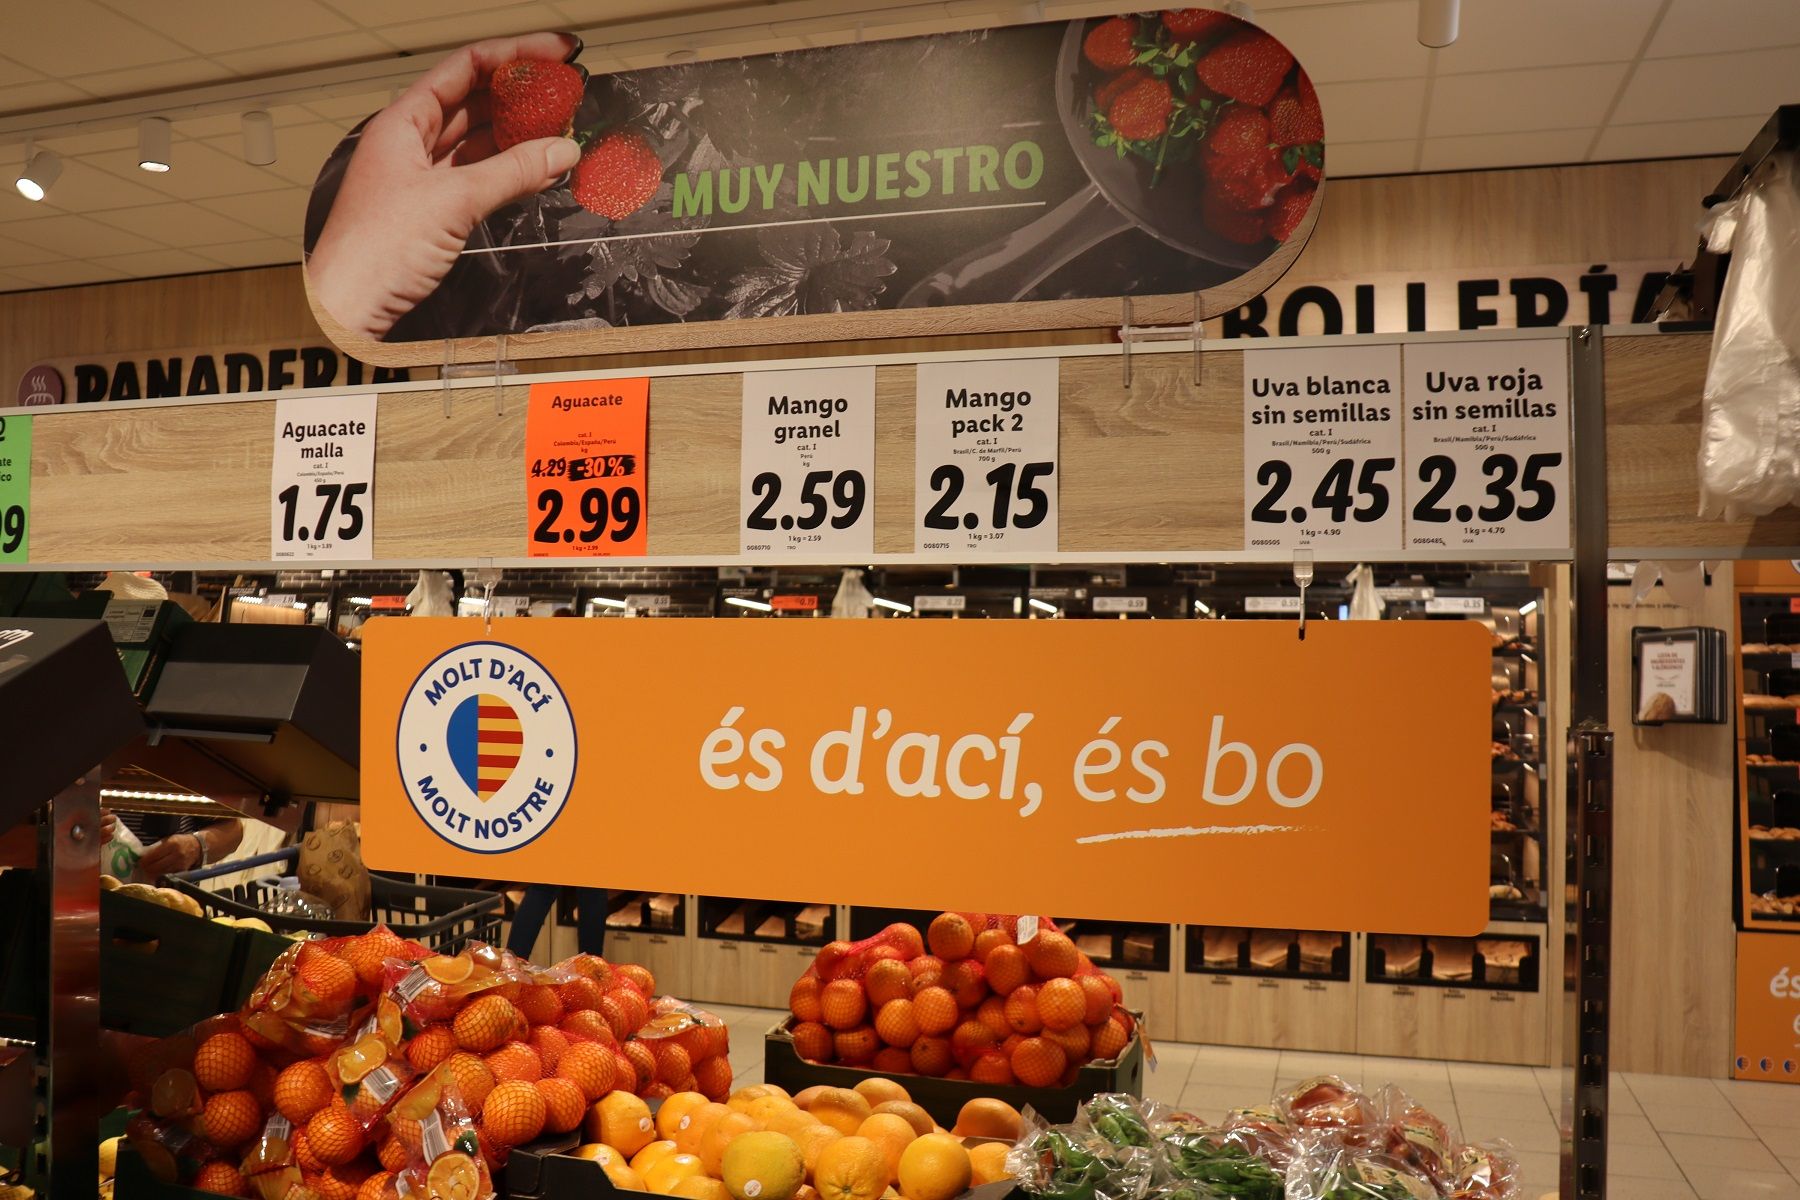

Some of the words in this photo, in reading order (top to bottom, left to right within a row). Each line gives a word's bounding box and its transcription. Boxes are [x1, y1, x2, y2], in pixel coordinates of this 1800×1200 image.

[672, 162, 786, 218] MUY
[798, 140, 1044, 206] NUESTRO
[1252, 378, 1300, 397] Uva
[1306, 376, 1390, 395] blanca
[1426, 371, 1480, 392] Uva
[1488, 367, 1543, 396] roja
[552, 394, 623, 411] Aguacate
[768, 395, 848, 418] Mango
[946, 388, 1031, 411] Mango
[1413, 401, 1447, 420] sin
[1455, 398, 1557, 419] semillas
[952, 414, 1004, 438] pack
[1011, 414, 1023, 432] 2
[1252, 406, 1286, 425] sin
[1293, 404, 1391, 424] semillas
[282, 420, 366, 443] Aguacate
[774, 420, 840, 444] granel
[301, 442, 344, 458] malla
[531, 457, 567, 478] 4.29
[924, 462, 1054, 530] 2.15
[1251, 458, 1395, 524] 2.45
[1413, 452, 1562, 522] 2.35
[278, 482, 368, 541] 1.75
[747, 470, 866, 530] 2.59
[534, 486, 640, 543] 2.99
[0, 504, 24, 554] 9
[1306, 529, 1316, 538] kg
[1469, 527, 1480, 535] kg
[424, 658, 483, 706] MOLT
[489, 658, 552, 713] D'ACÍ
[698, 706, 786, 793] és
[809, 706, 1044, 818] d'ací,
[1073, 716, 1170, 804] és
[1202, 714, 1325, 808] bo
[417, 775, 471, 833] MOLT
[474, 777, 554, 839] NOSTRE
